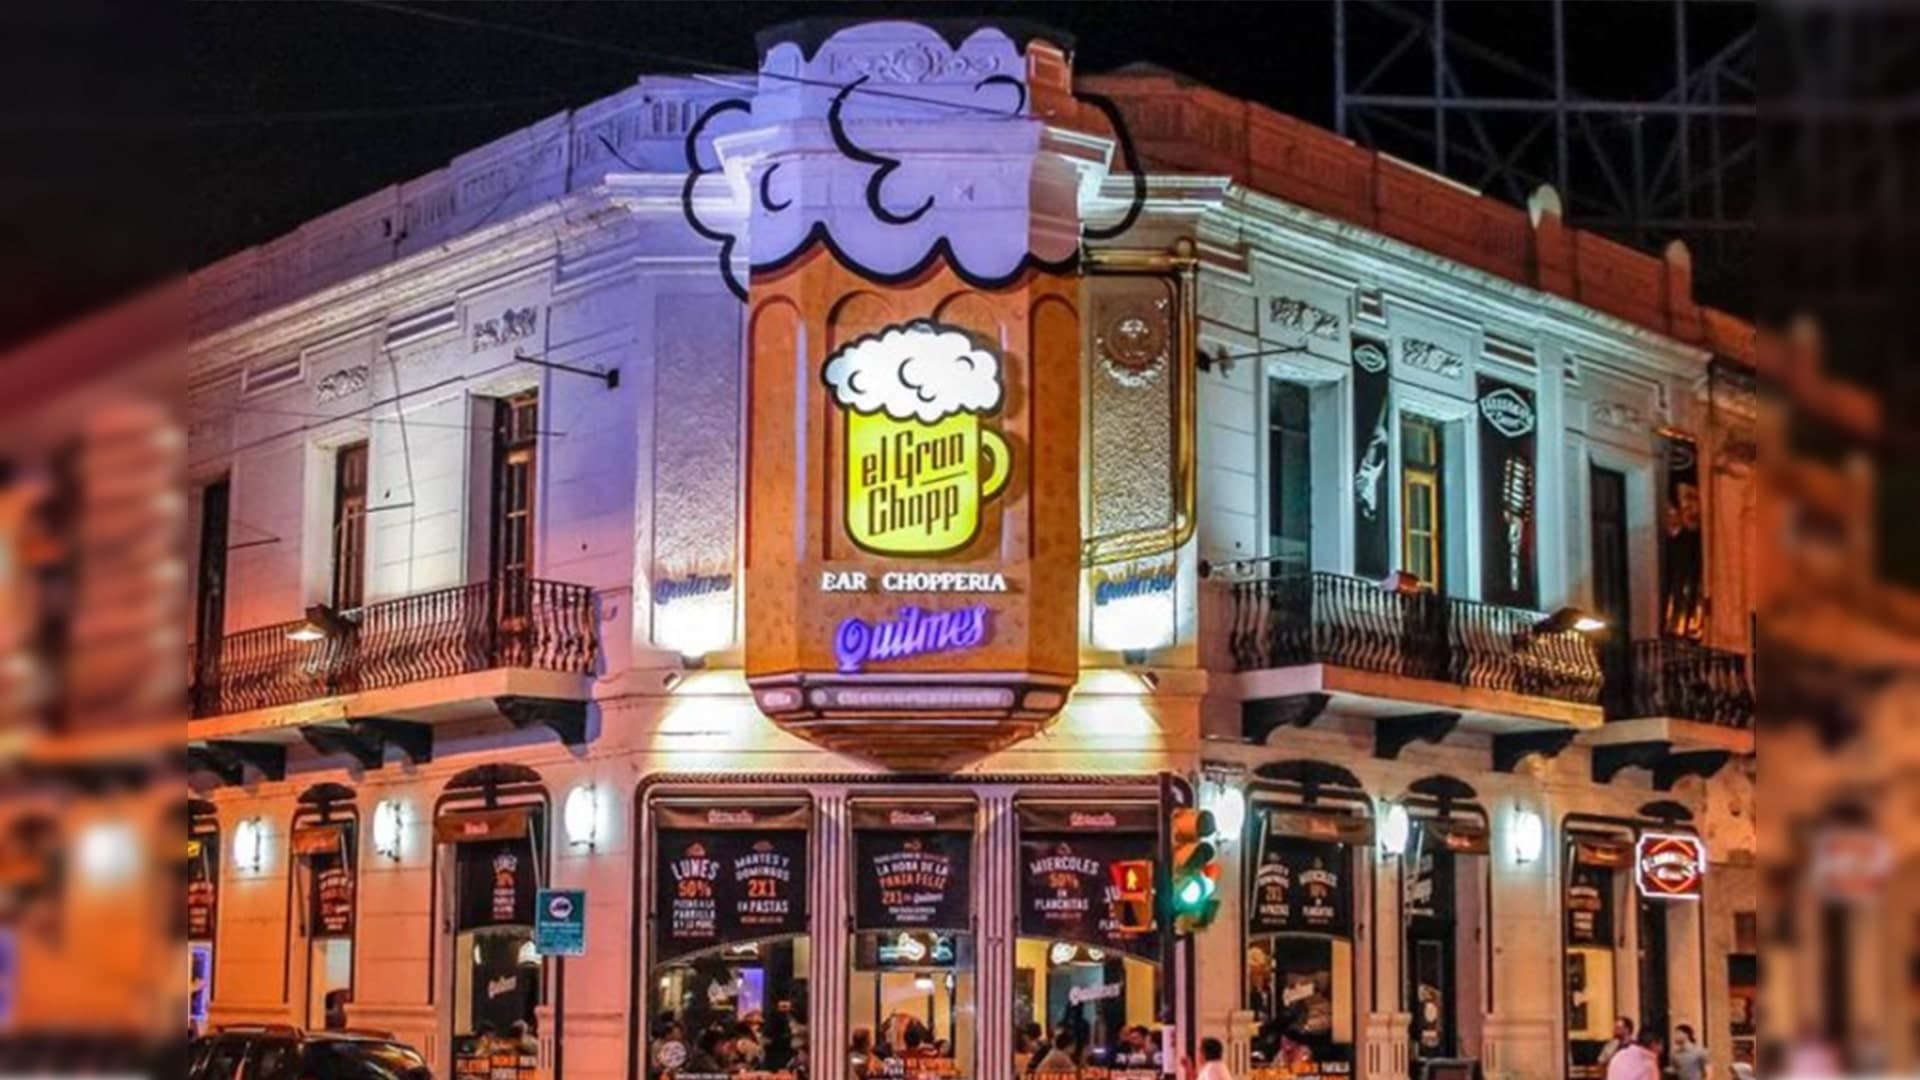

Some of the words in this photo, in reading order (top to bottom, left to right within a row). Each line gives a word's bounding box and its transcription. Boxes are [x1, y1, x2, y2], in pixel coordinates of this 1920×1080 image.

[861, 435, 887, 487] el
[894, 430, 964, 488] Gran
[881, 571, 1007, 592] CHOPPERIA
[834, 602, 989, 673] Quilmes
[671, 858, 720, 881] LUNES
[1029, 856, 1100, 876] MIERCOLES
[677, 880, 712, 898] 50%
[747, 879, 777, 898] 2X1
[749, 900, 789, 914] PASTAS
